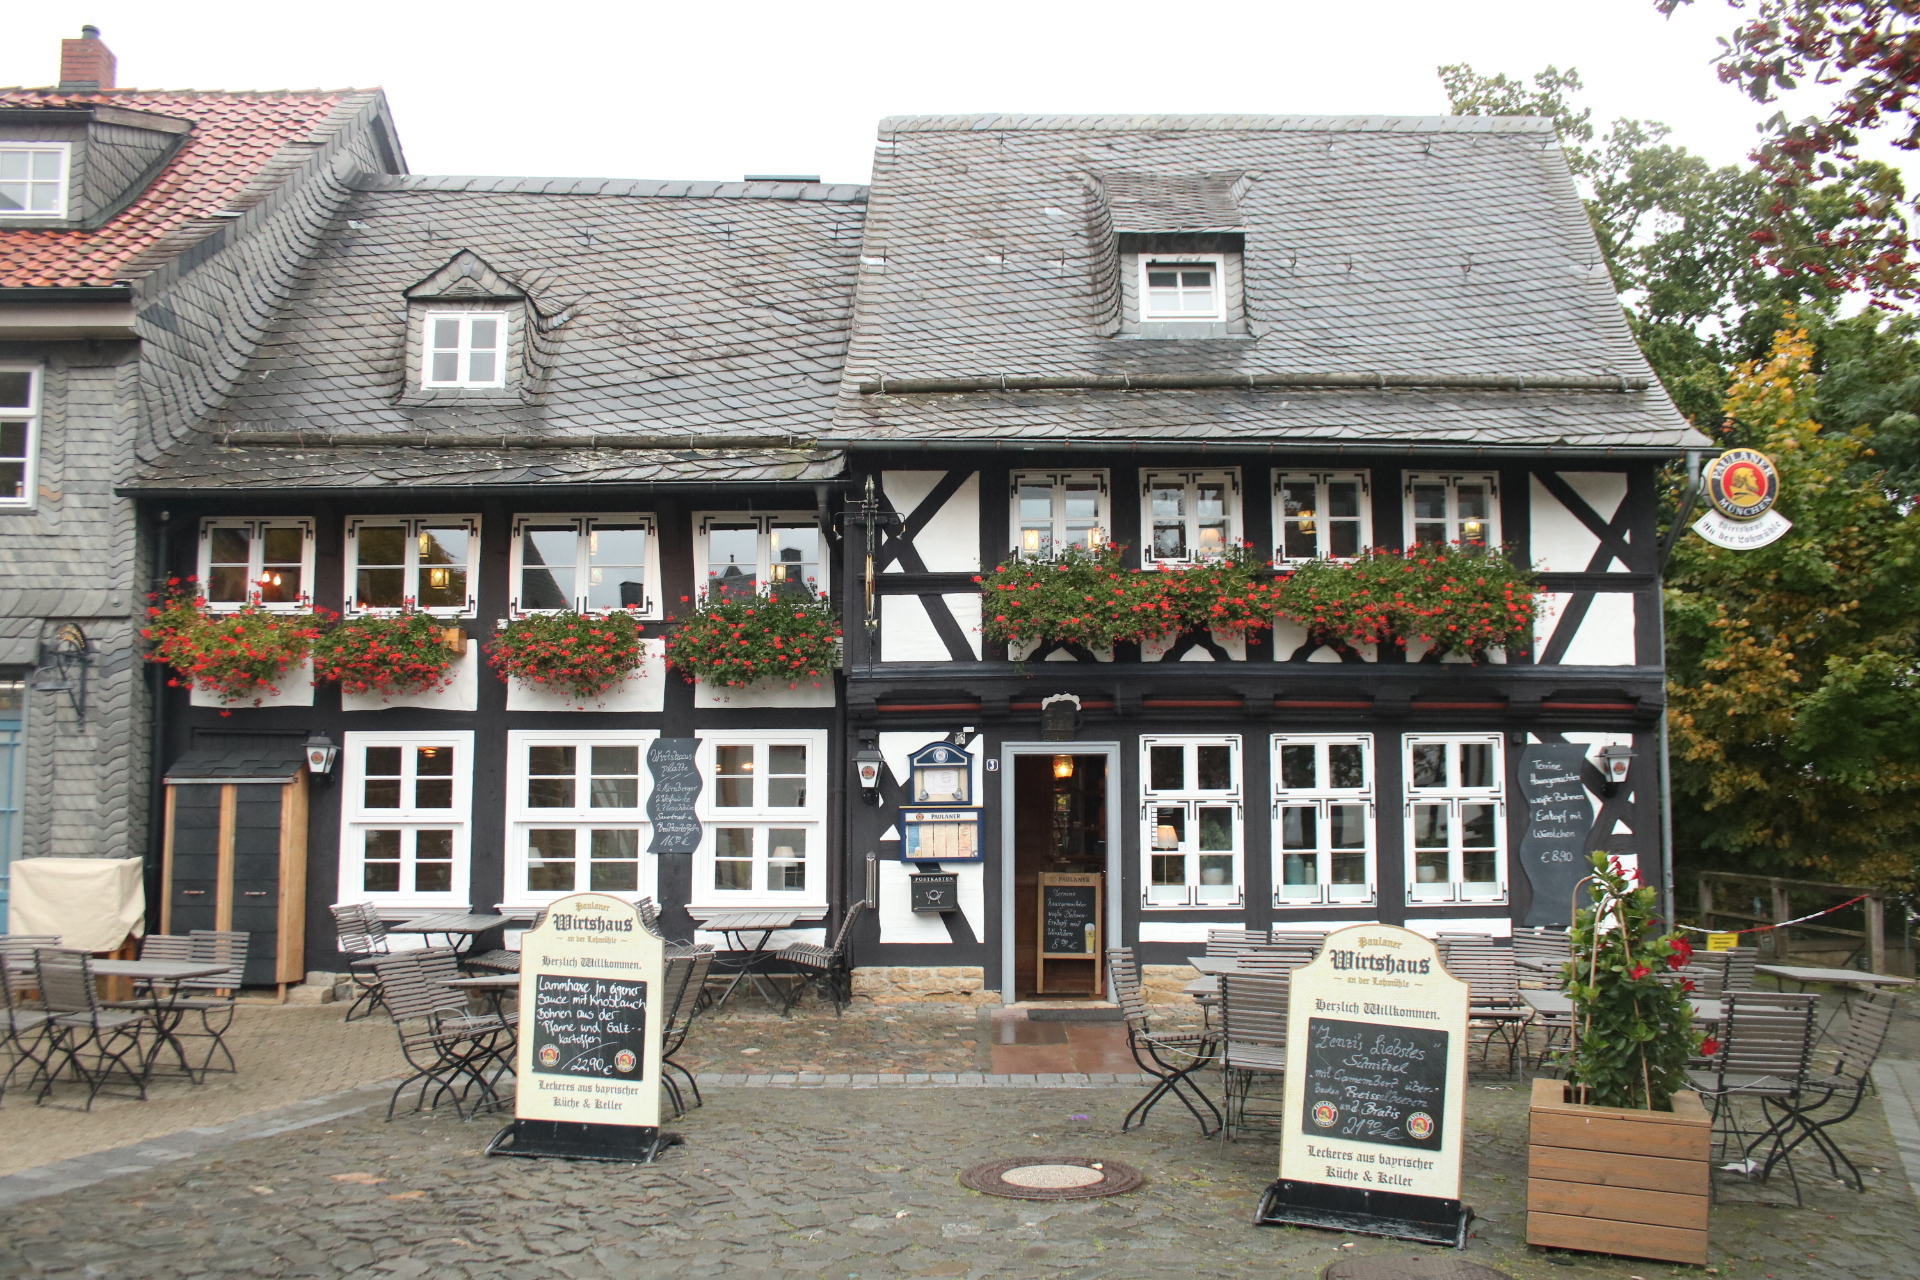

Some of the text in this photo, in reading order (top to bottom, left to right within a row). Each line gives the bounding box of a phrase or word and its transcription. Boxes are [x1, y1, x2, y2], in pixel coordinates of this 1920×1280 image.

[1712, 451, 1774, 480] PAULANER
[1719, 533, 1734, 542] der
[989, 760, 995, 770] 3
[1532, 759, 1563, 771] Terrine
[575, 902, 610, 912] Paulaner
[552, 914, 634, 934] Wirtshaus
[1358, 936, 1402, 950] Paulaner
[542, 955, 642, 970] Herzlich Willkommen.
[1329, 949, 1431, 975] Wirtshaus
[539, 976, 592, 993] Lammhaxe
[1358, 977, 1369, 985] der
[537, 993, 569, 1005] Sauce
[572, 994, 587, 1005] mit
[537, 1008, 620, 1020] Bohnen aus der
[1315, 998, 1440, 1020] Herzlich Willkommen.
[542, 1021, 576, 1036] Pfanne
[580, 1021, 601, 1034] und
[1315, 1066, 1332, 1079] mit
[1333, 1068, 1399, 1088] Camembert
[538, 1080, 639, 1096] Leckeres aus bayrischer
[553, 1096, 623, 1111] Küche & Keller
[1340, 1100, 1360, 1113] und
[1307, 1145, 1435, 1171] Leckeres aus bayrischer
[1325, 1166, 1413, 1187] Küche & Keller
